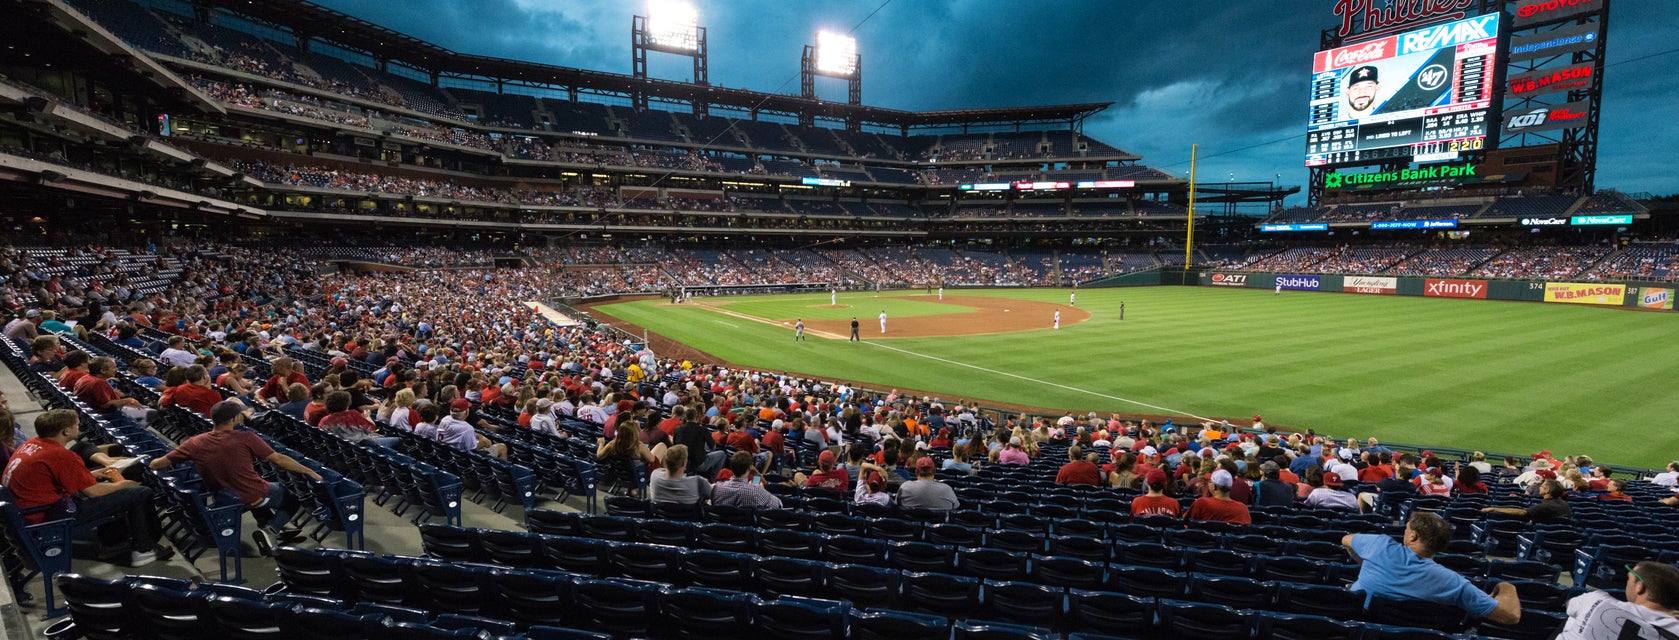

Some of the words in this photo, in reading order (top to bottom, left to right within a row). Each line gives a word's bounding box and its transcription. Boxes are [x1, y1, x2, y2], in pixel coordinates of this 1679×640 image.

[1538, 0, 1592, 13] TOYO
[1403, 16, 1490, 54] RE/MAX
[1512, 35, 1583, 54] Independence
[1449, 142, 1458, 152] 2
[1461, 140, 1470, 151] 2
[1472, 138, 1482, 149] 0
[1344, 171, 1398, 184] Citizens
[1400, 165, 1438, 180] Bank
[1440, 162, 1476, 177] Park
[1529, 217, 1567, 226] NovaCare
[1586, 216, 1627, 225] NovaCare
[1223, 274, 1247, 283] ATI
[1275, 276, 1319, 288] StubHub
[1428, 280, 1483, 297] xfinity
[1529, 282, 1543, 290] 374
[1644, 292, 1666, 304] Gulf
